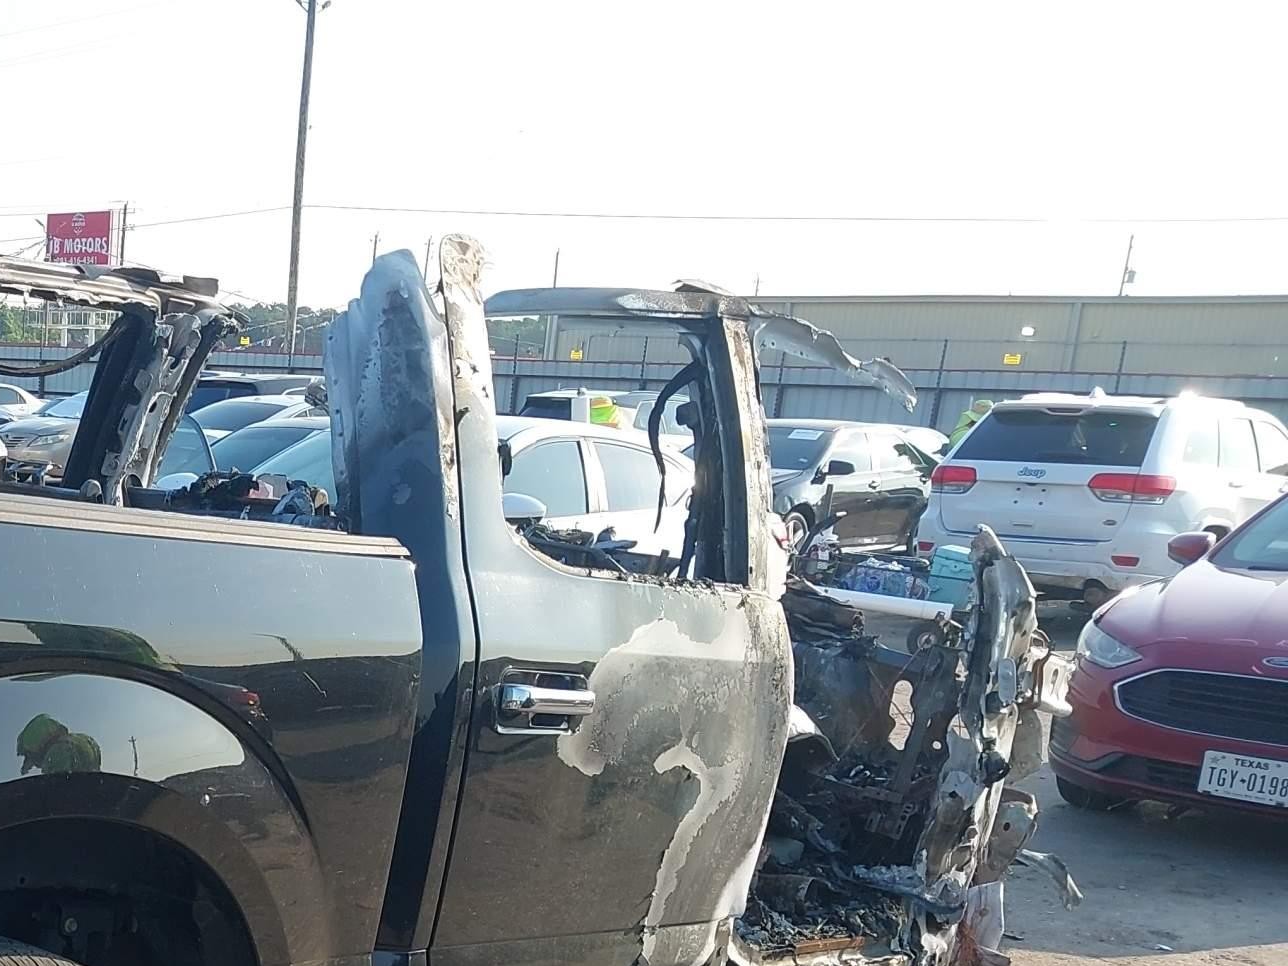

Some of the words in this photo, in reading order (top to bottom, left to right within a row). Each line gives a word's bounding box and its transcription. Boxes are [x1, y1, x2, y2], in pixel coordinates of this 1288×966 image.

[63, 237, 107, 254] MOTORS
[1017, 466, 1047, 479] Jeep
[1234, 757, 1270, 771] TEXAS
